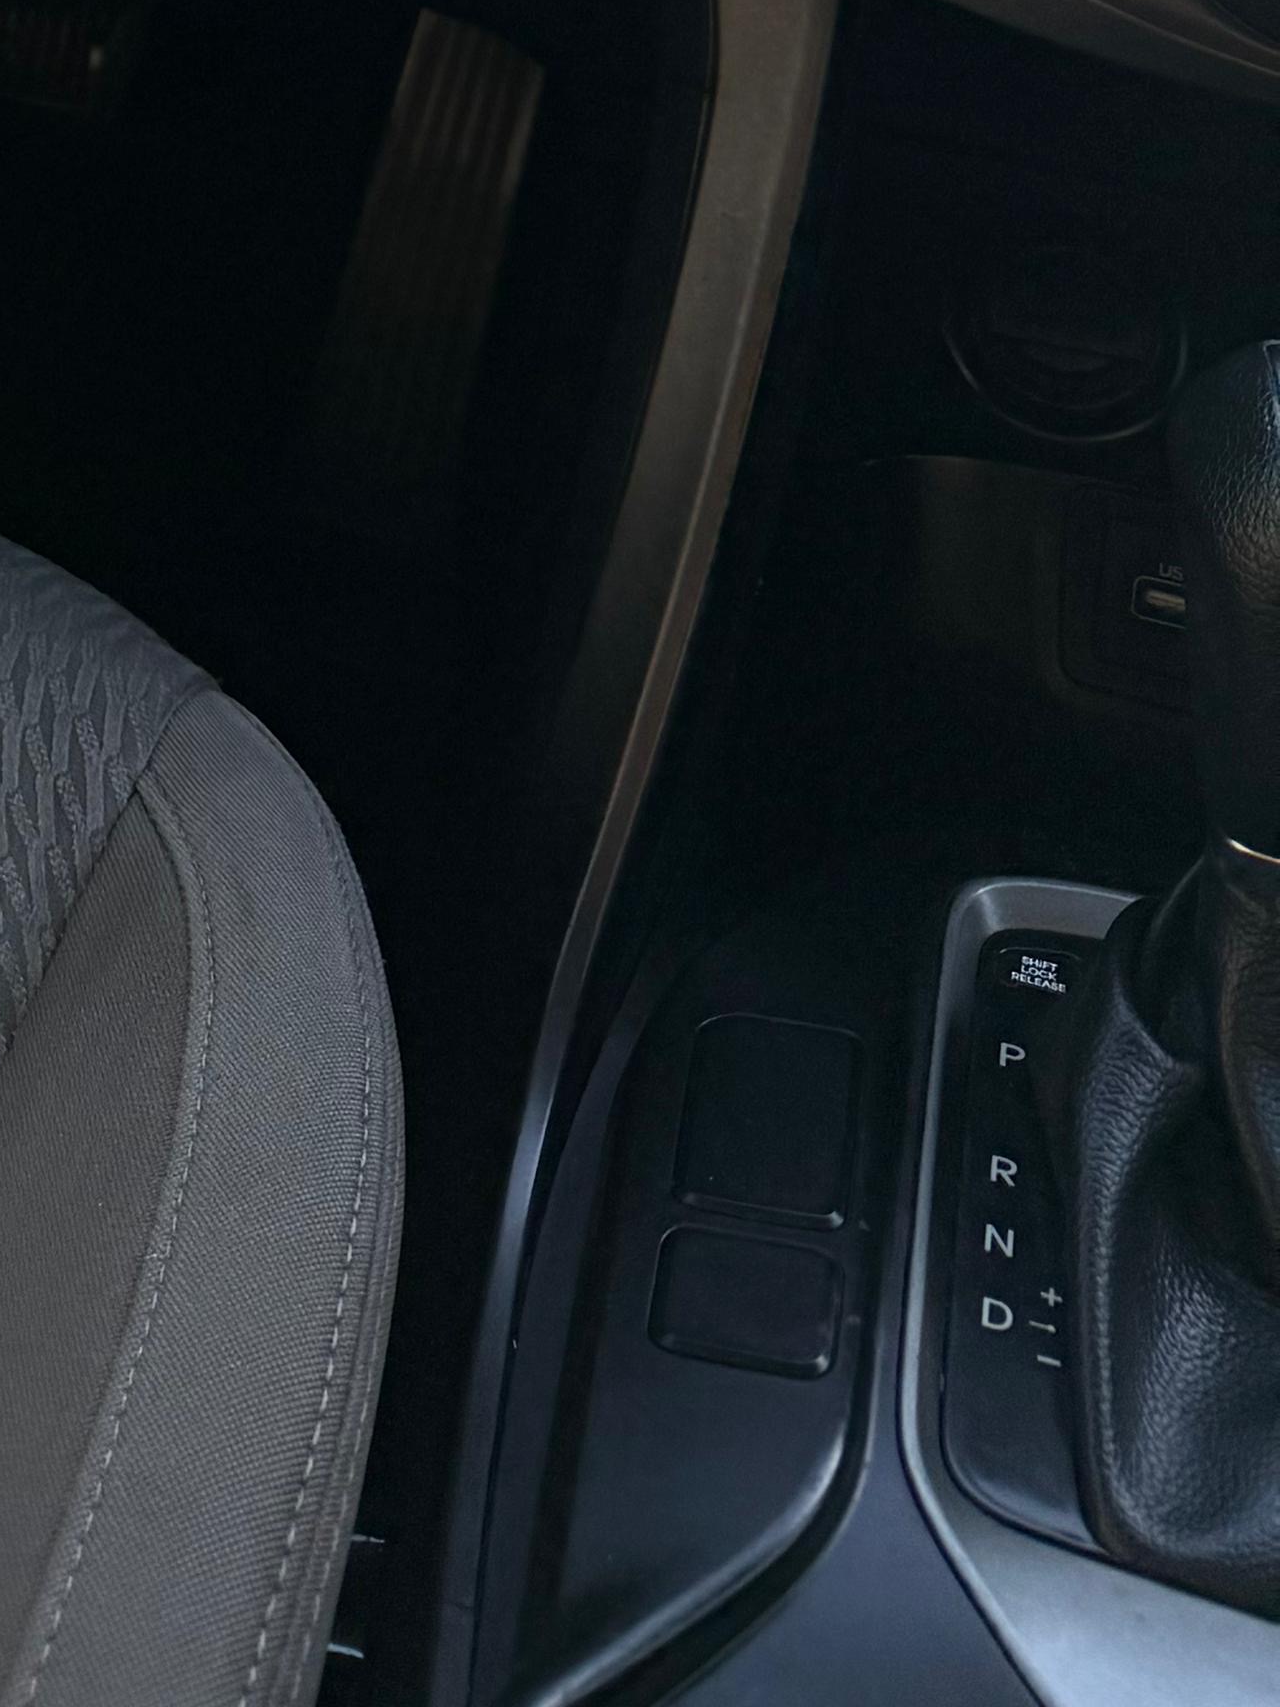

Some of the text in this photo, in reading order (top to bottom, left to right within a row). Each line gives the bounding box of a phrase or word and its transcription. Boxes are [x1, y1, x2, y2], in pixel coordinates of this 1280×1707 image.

[1159, 563, 1183, 581] US
[1020, 965, 1057, 982] LOCK
[1021, 955, 1058, 972] SHIFT
[1011, 971, 1066, 994] RELEASE
[998, 1042, 1026, 1067] P
[990, 1155, 1018, 1187] R
[983, 1224, 1015, 1258] N
[980, 1297, 1013, 1331] D
